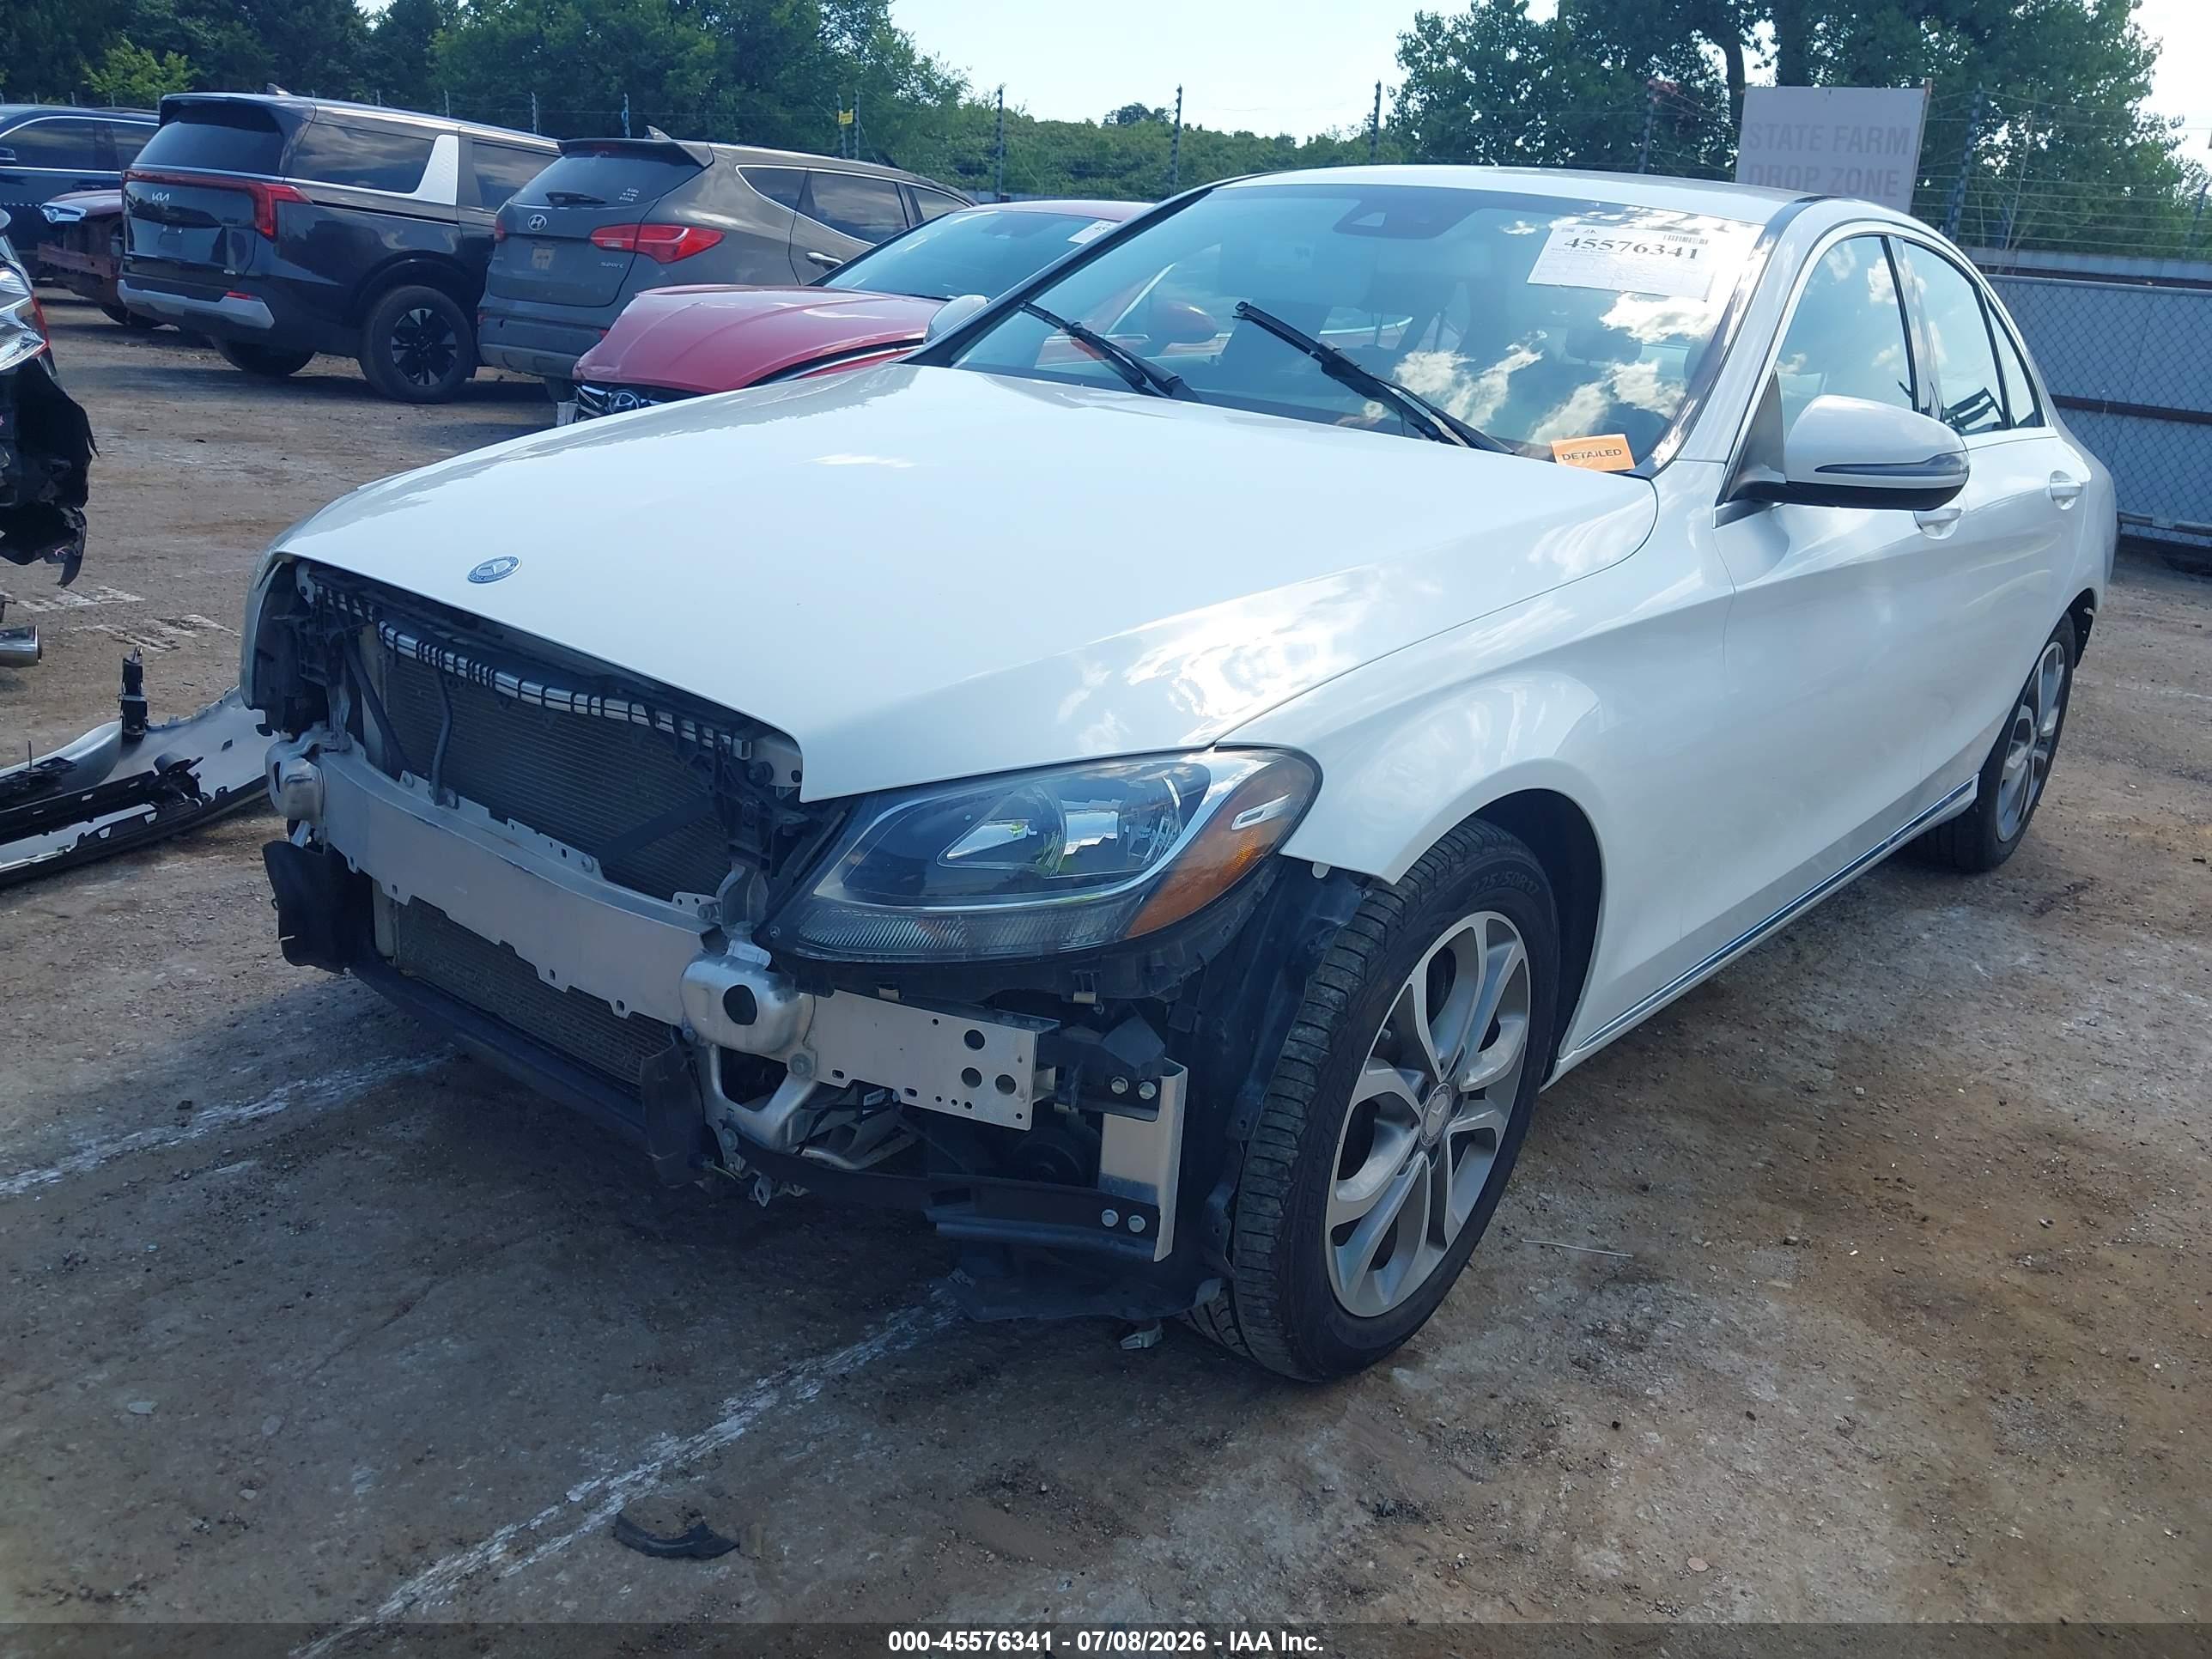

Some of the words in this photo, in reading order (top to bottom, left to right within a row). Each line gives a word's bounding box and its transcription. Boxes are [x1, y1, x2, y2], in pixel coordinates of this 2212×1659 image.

[1747, 123, 1825, 152] STATE
[1832, 125, 1911, 156] FARM
[1747, 164, 1821, 192] DROP
[1827, 167, 1900, 198] ZONE
[151, 191, 170, 201] KIA
[1564, 236, 1699, 260] 45576341
[1561, 448, 1622, 461] DETAILED
